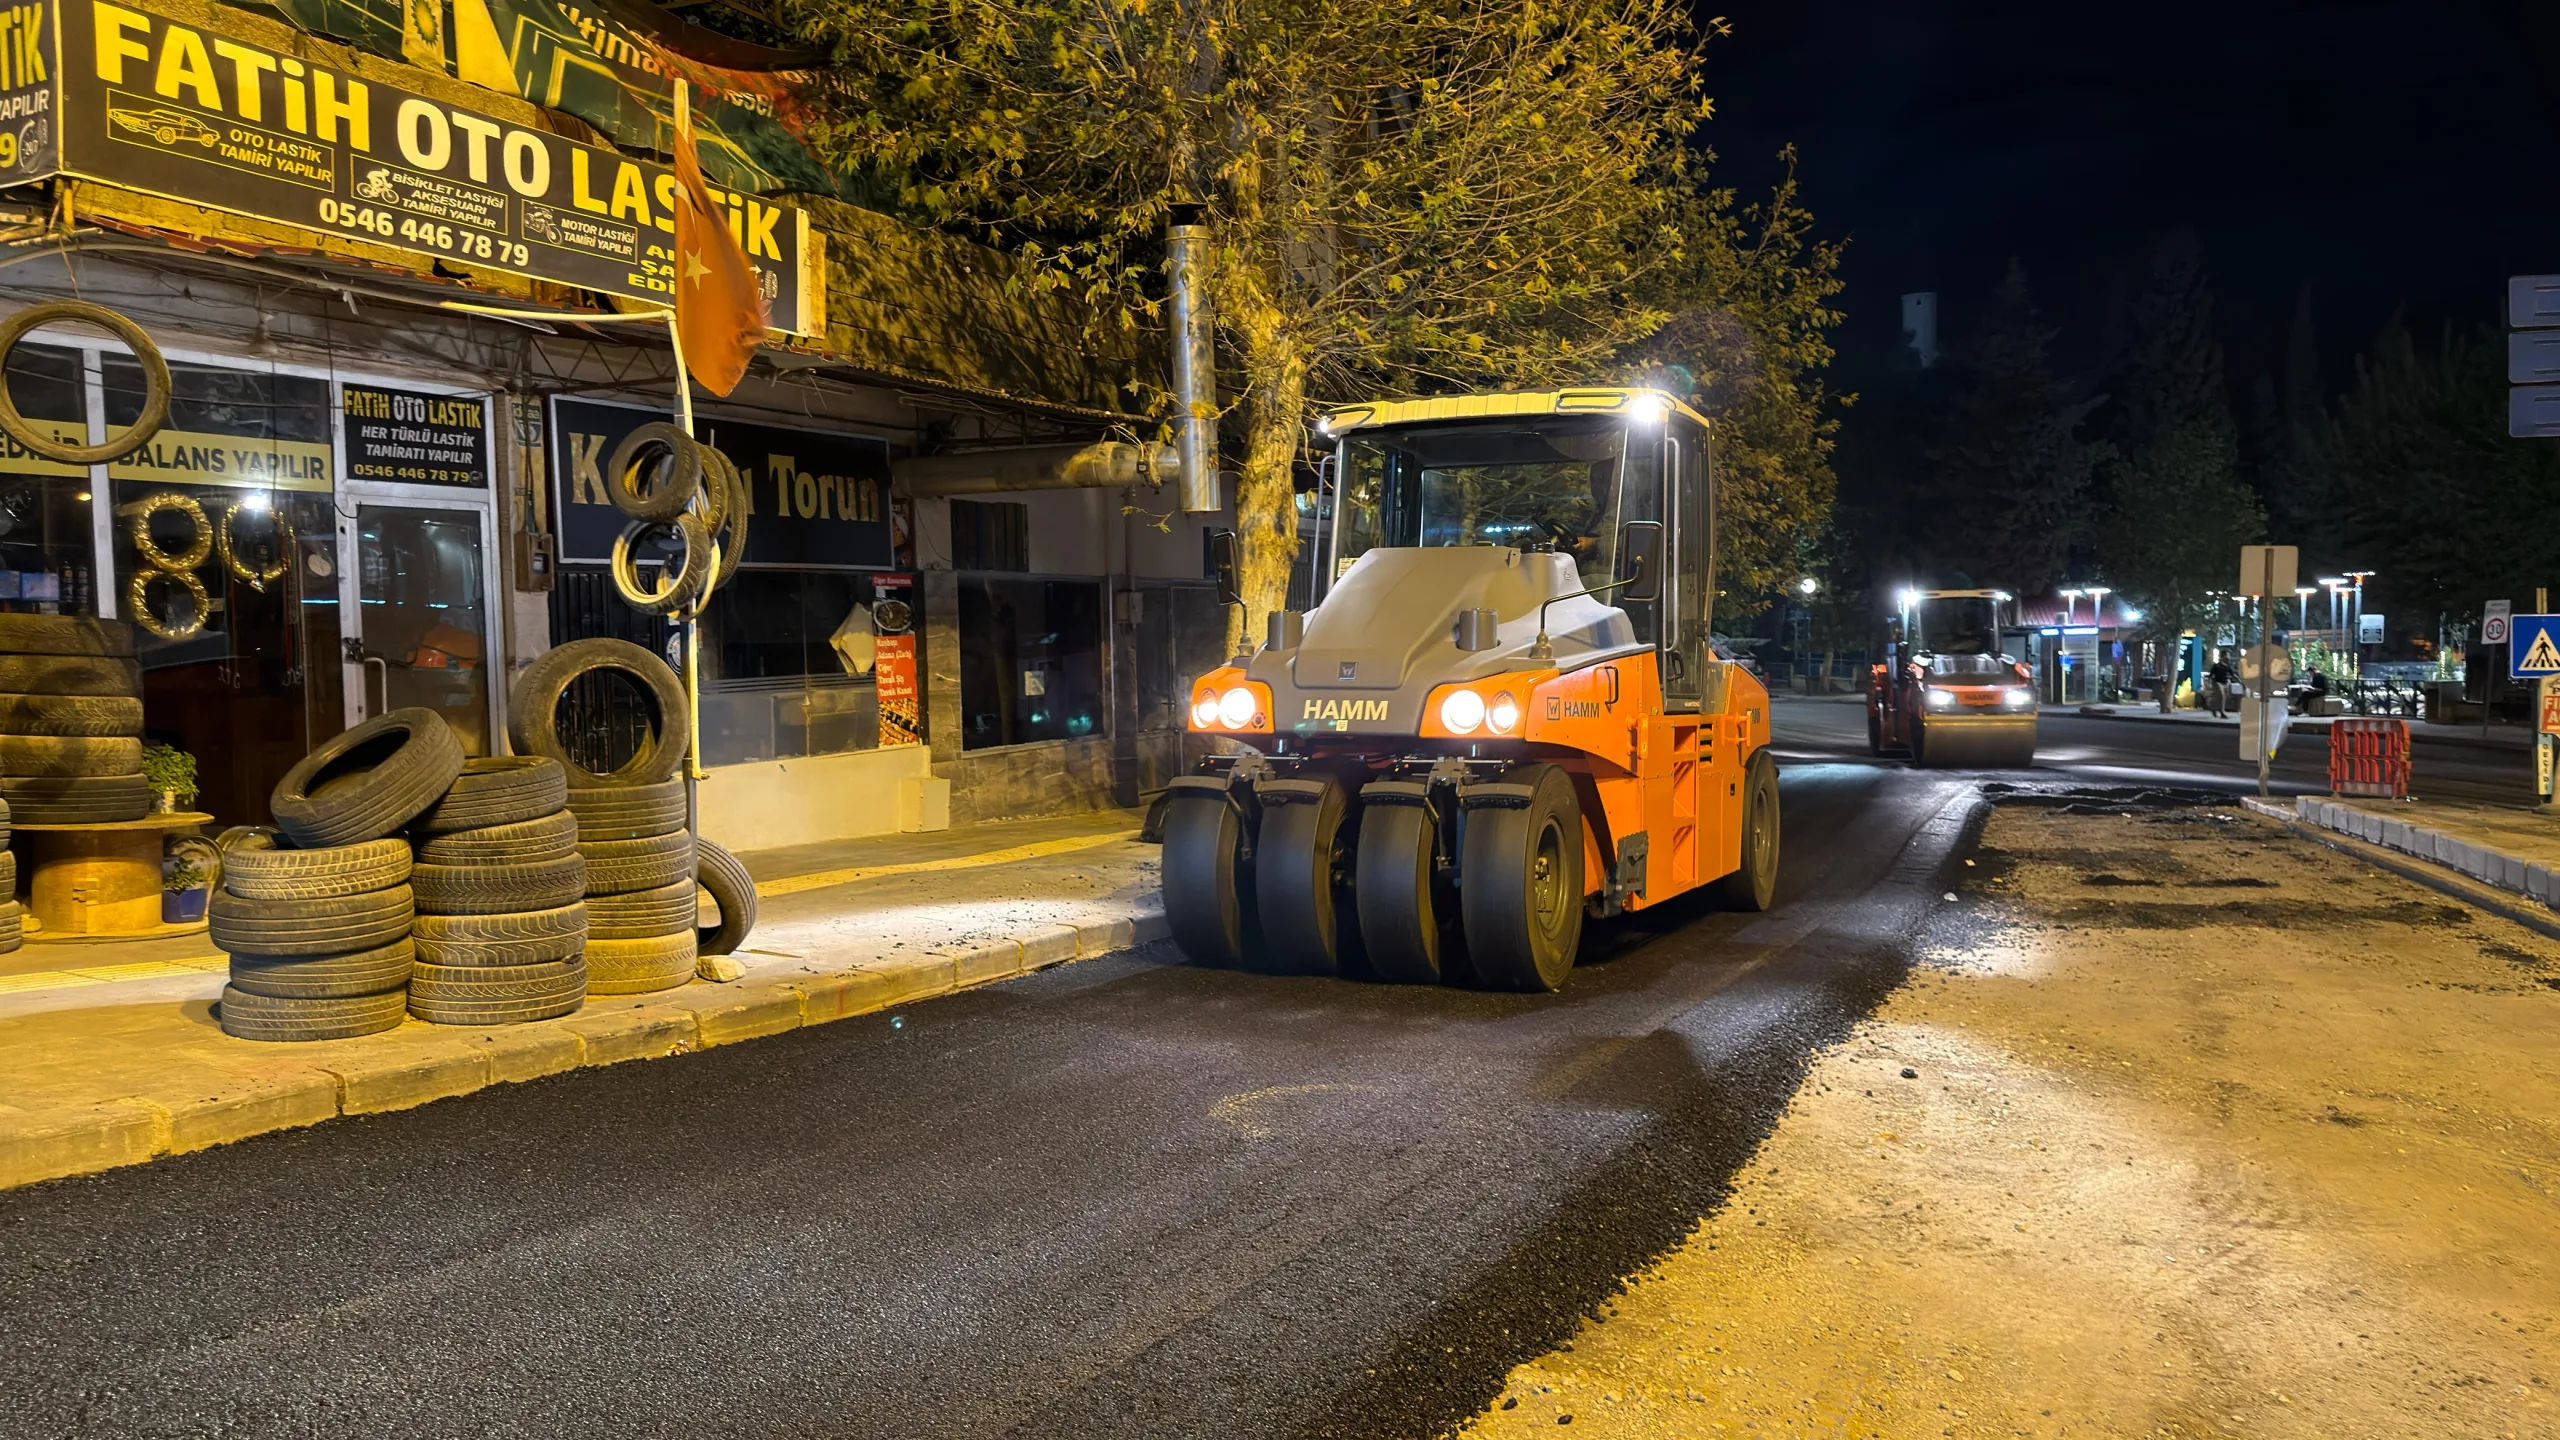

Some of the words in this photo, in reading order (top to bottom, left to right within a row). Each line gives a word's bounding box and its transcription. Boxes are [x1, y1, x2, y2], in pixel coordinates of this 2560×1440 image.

[0, 89, 50, 121] APILIR
[230, 129, 264, 147] OTO
[268, 139, 322, 164] LASTİK
[397, 98, 551, 198] OTO
[219, 143, 273, 167] TAMİRİ
[275, 158, 333, 183] YAPILIR
[392, 173, 454, 196] BİSİKLET
[402, 198, 447, 217] TAMİRİ
[450, 209, 497, 229] YAPILIR
[411, 189, 487, 216] AKSESUARI
[319, 198, 395, 237] 0546
[400, 218, 454, 250] 446
[459, 230, 493, 259] 78
[497, 239, 530, 267] 79
[561, 218, 597, 236] MOTOR
[563, 231, 596, 248] TAMİRİ
[597, 239, 633, 257] YAPILIR
[640, 259, 675, 278] ŞA
[628, 272, 676, 295] EDİ
[393, 395, 426, 424] OTO
[361, 425, 388, 440] HER
[391, 427, 431, 444] TÜRLÜ
[433, 432, 475, 448] LASTİK
[117, 441, 226, 473] BALANS
[232, 450, 325, 481] YAPILIR
[365, 443, 424, 460] TAMİRATI
[428, 448, 473, 464] YAPILIR
[354, 464, 395, 478] 0546
[398, 467, 427, 480] 446
[429, 469, 449, 481] 78
[452, 471, 470, 483] 79
[768, 453, 880, 523] Torun
[2489, 624, 2502, 635] 30
[1303, 699, 1389, 721] HAMM
[1564, 700, 1600, 718] HAMM
